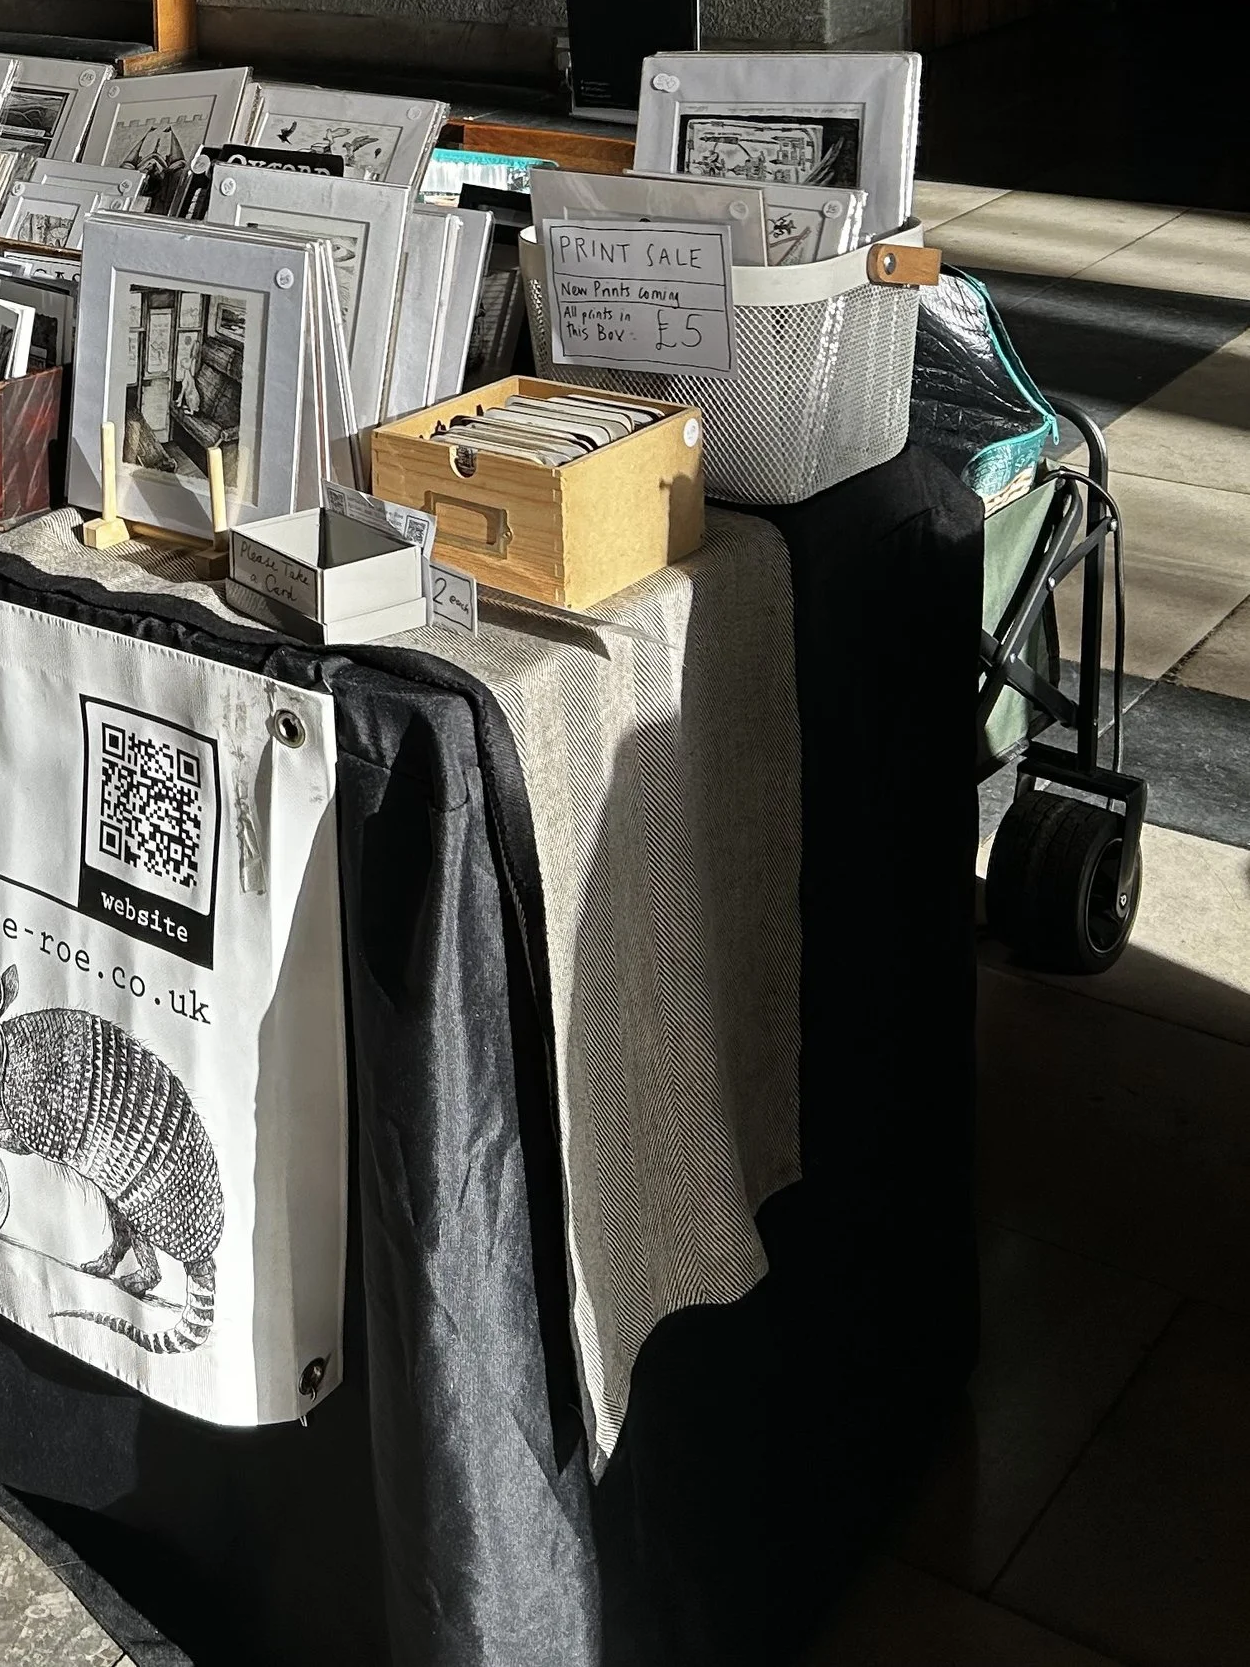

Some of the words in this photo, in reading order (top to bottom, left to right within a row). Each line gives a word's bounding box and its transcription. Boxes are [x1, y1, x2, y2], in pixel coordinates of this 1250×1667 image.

[559, 234, 631, 264] PRINT
[646, 243, 702, 270] SALE
[561, 282, 588, 296] New
[594, 281, 631, 300] Prints
[564, 305, 577, 318] All
[582, 308, 614, 324] prints
[620, 309, 632, 322] in
[566, 323, 588, 342] this
[656, 309, 702, 351] £5
[240, 540, 279, 573] Please
[280, 557, 311, 586] Take
[250, 574, 259, 584] a
[265, 574, 298, 602] Card
[448, 595, 470, 615] each
[100, 889, 189, 944] website
